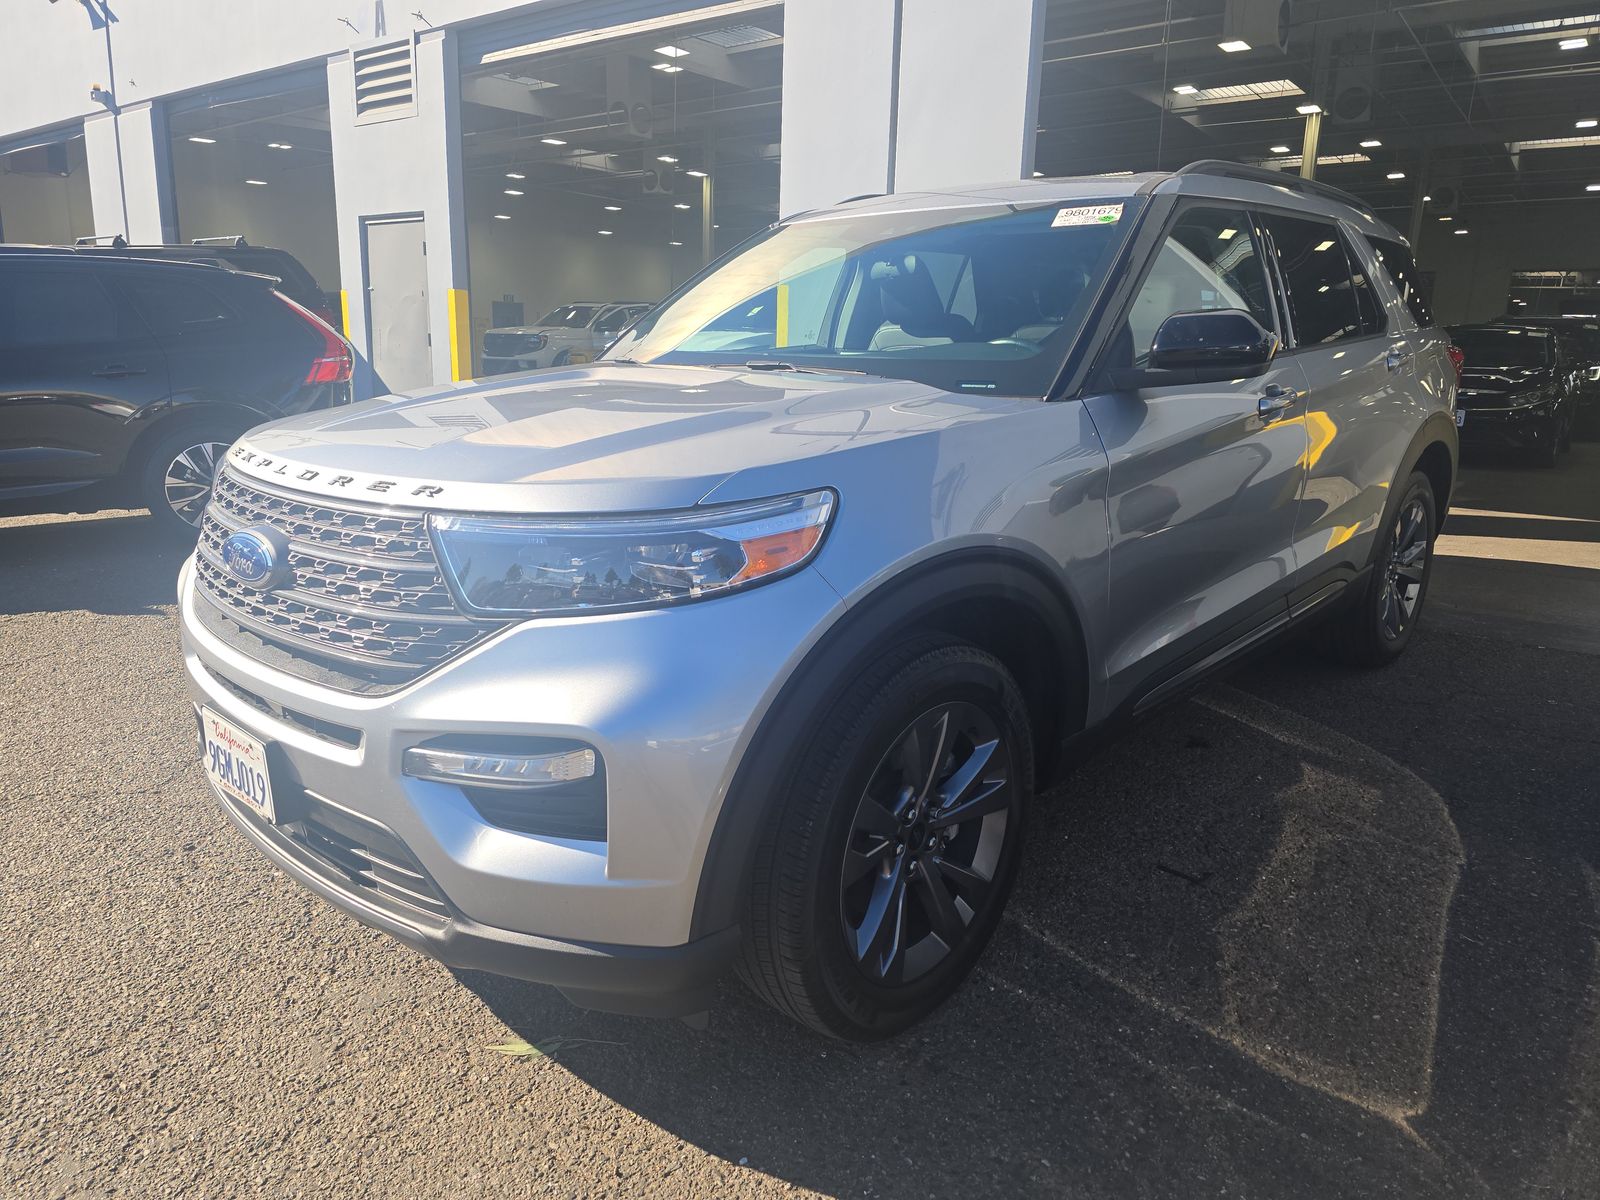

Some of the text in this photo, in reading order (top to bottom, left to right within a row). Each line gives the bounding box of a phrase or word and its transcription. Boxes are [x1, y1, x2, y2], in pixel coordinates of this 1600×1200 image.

[231, 447, 444, 498] EXPLORER
[228, 543, 255, 575] Ford
[208, 740, 266, 807] 9GMJ019
